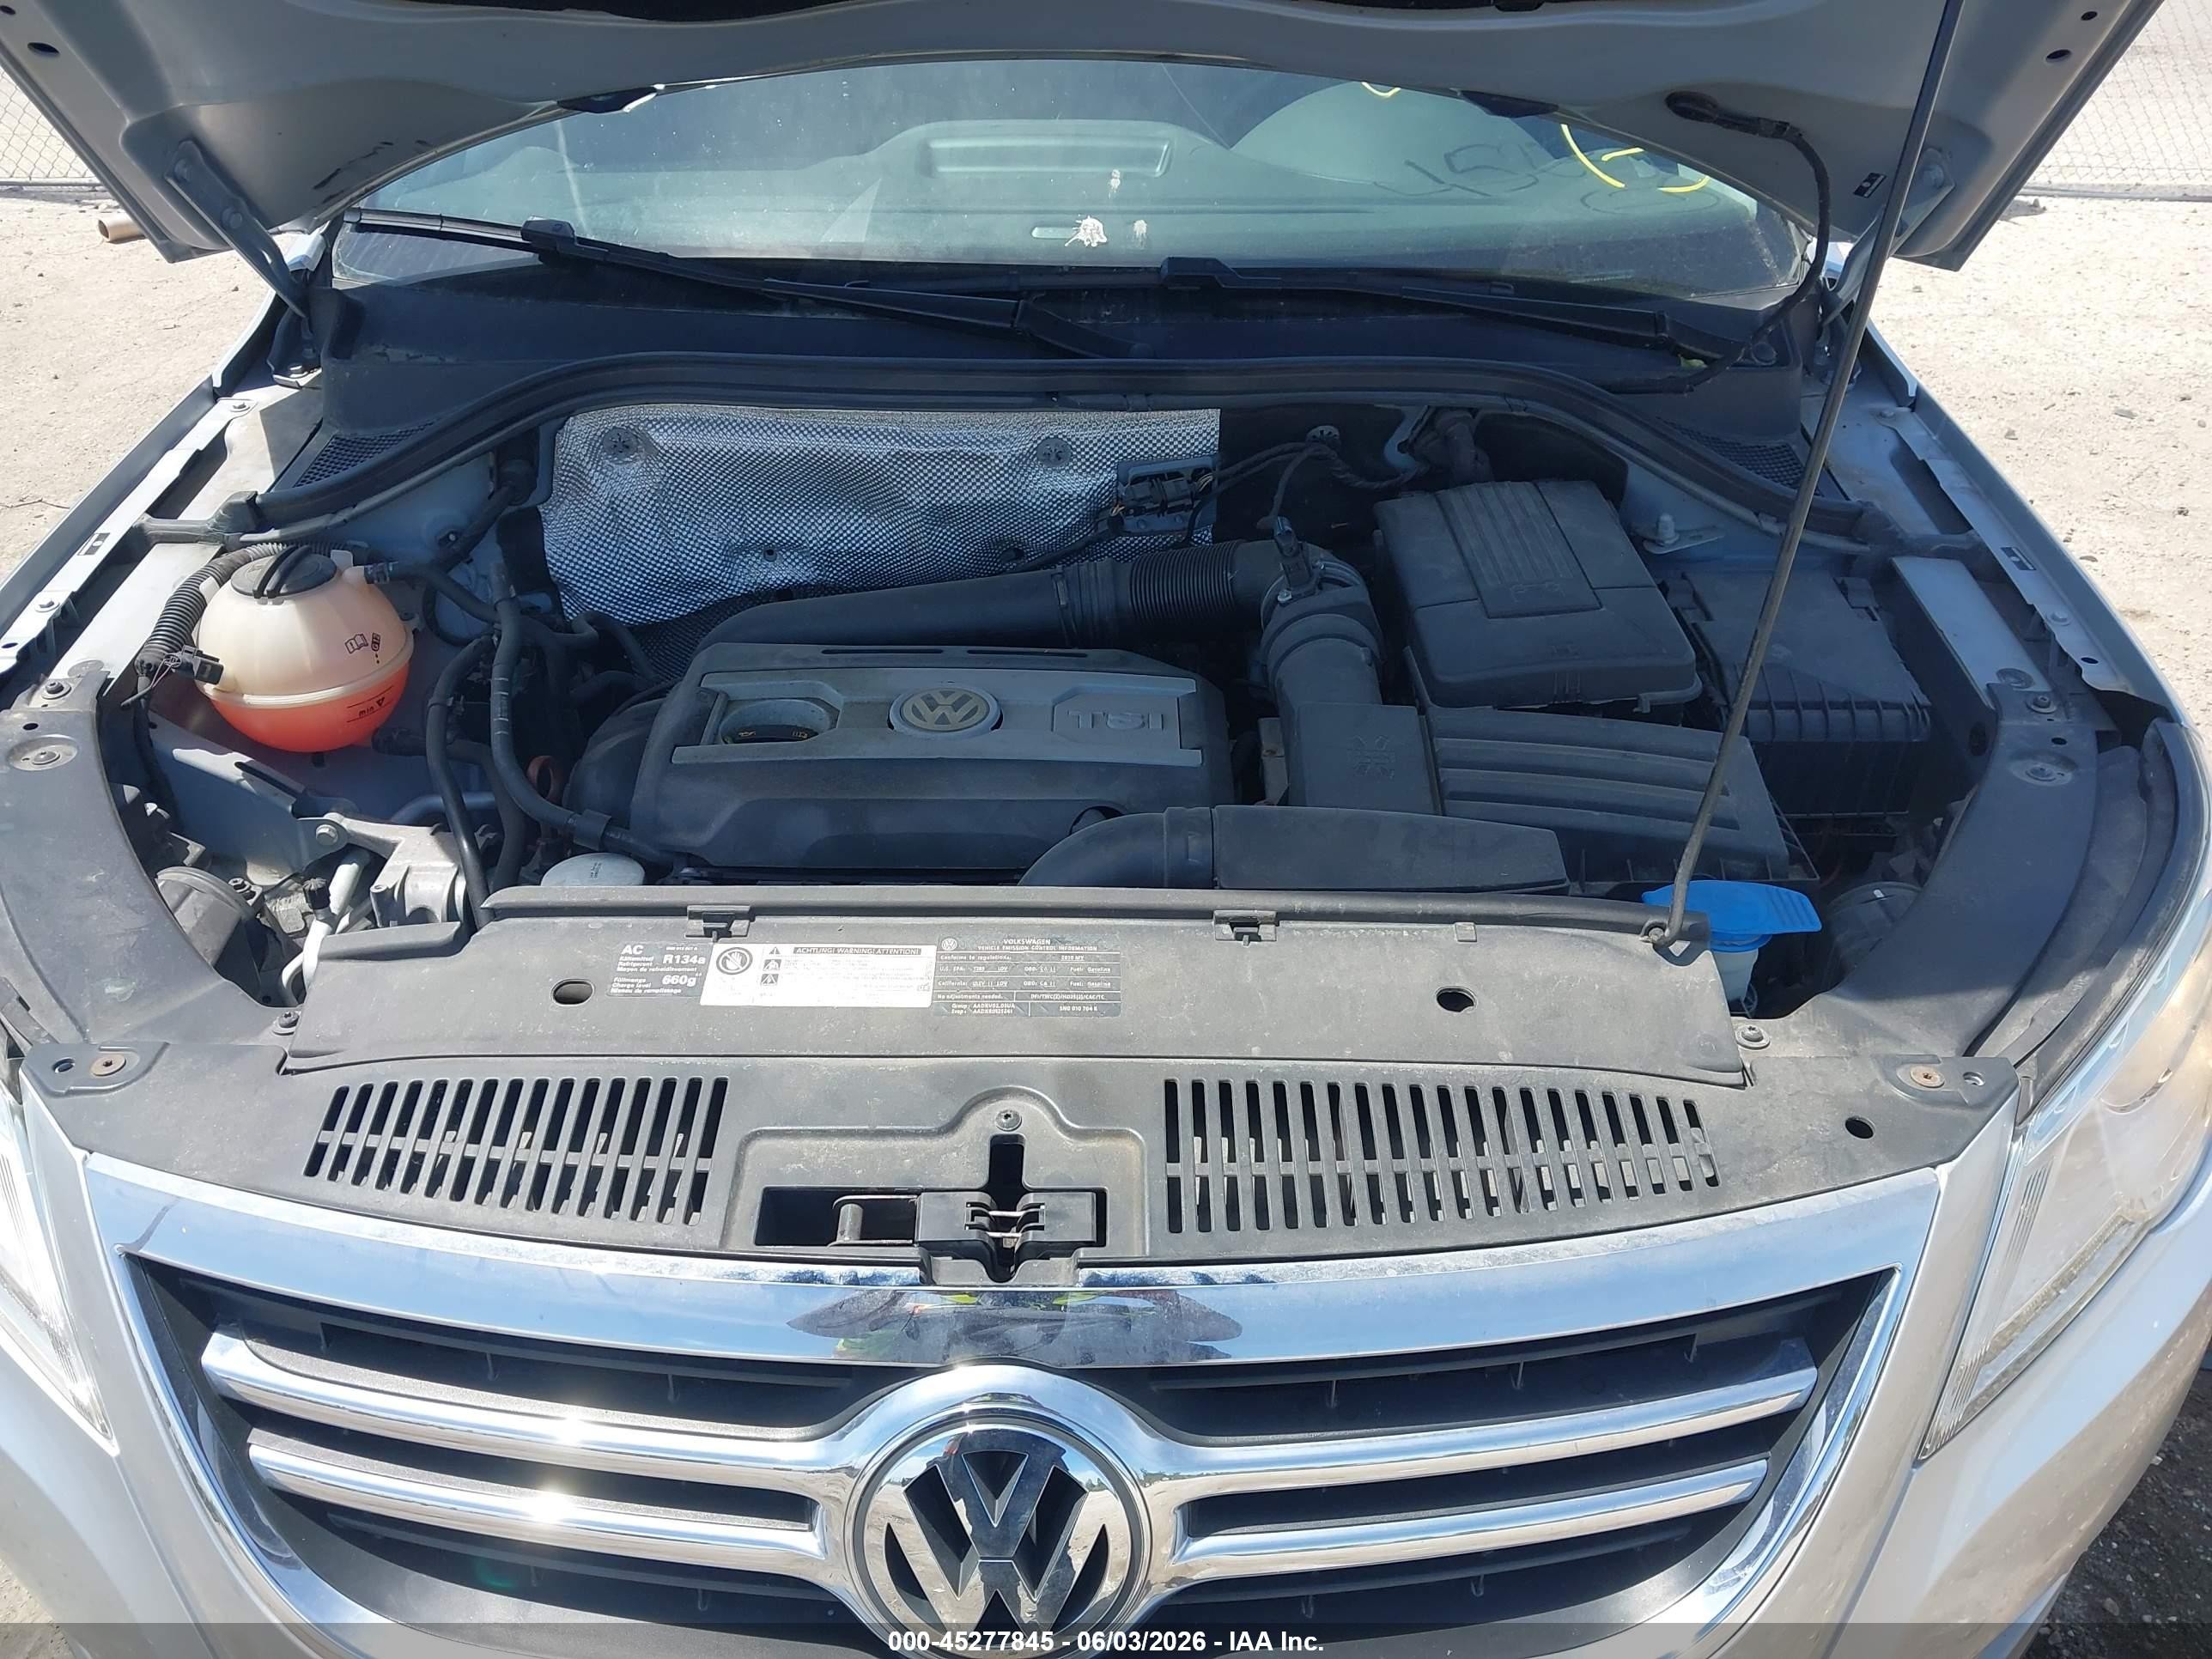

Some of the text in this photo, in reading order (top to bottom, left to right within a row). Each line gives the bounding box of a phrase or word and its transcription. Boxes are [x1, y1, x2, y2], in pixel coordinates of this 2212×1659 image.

[359, 706, 374, 716] min
[1068, 711, 1164, 730] TSI
[621, 945, 644, 955] AC
[662, 954, 706, 964] R134a
[662, 975, 696, 987] 660g
